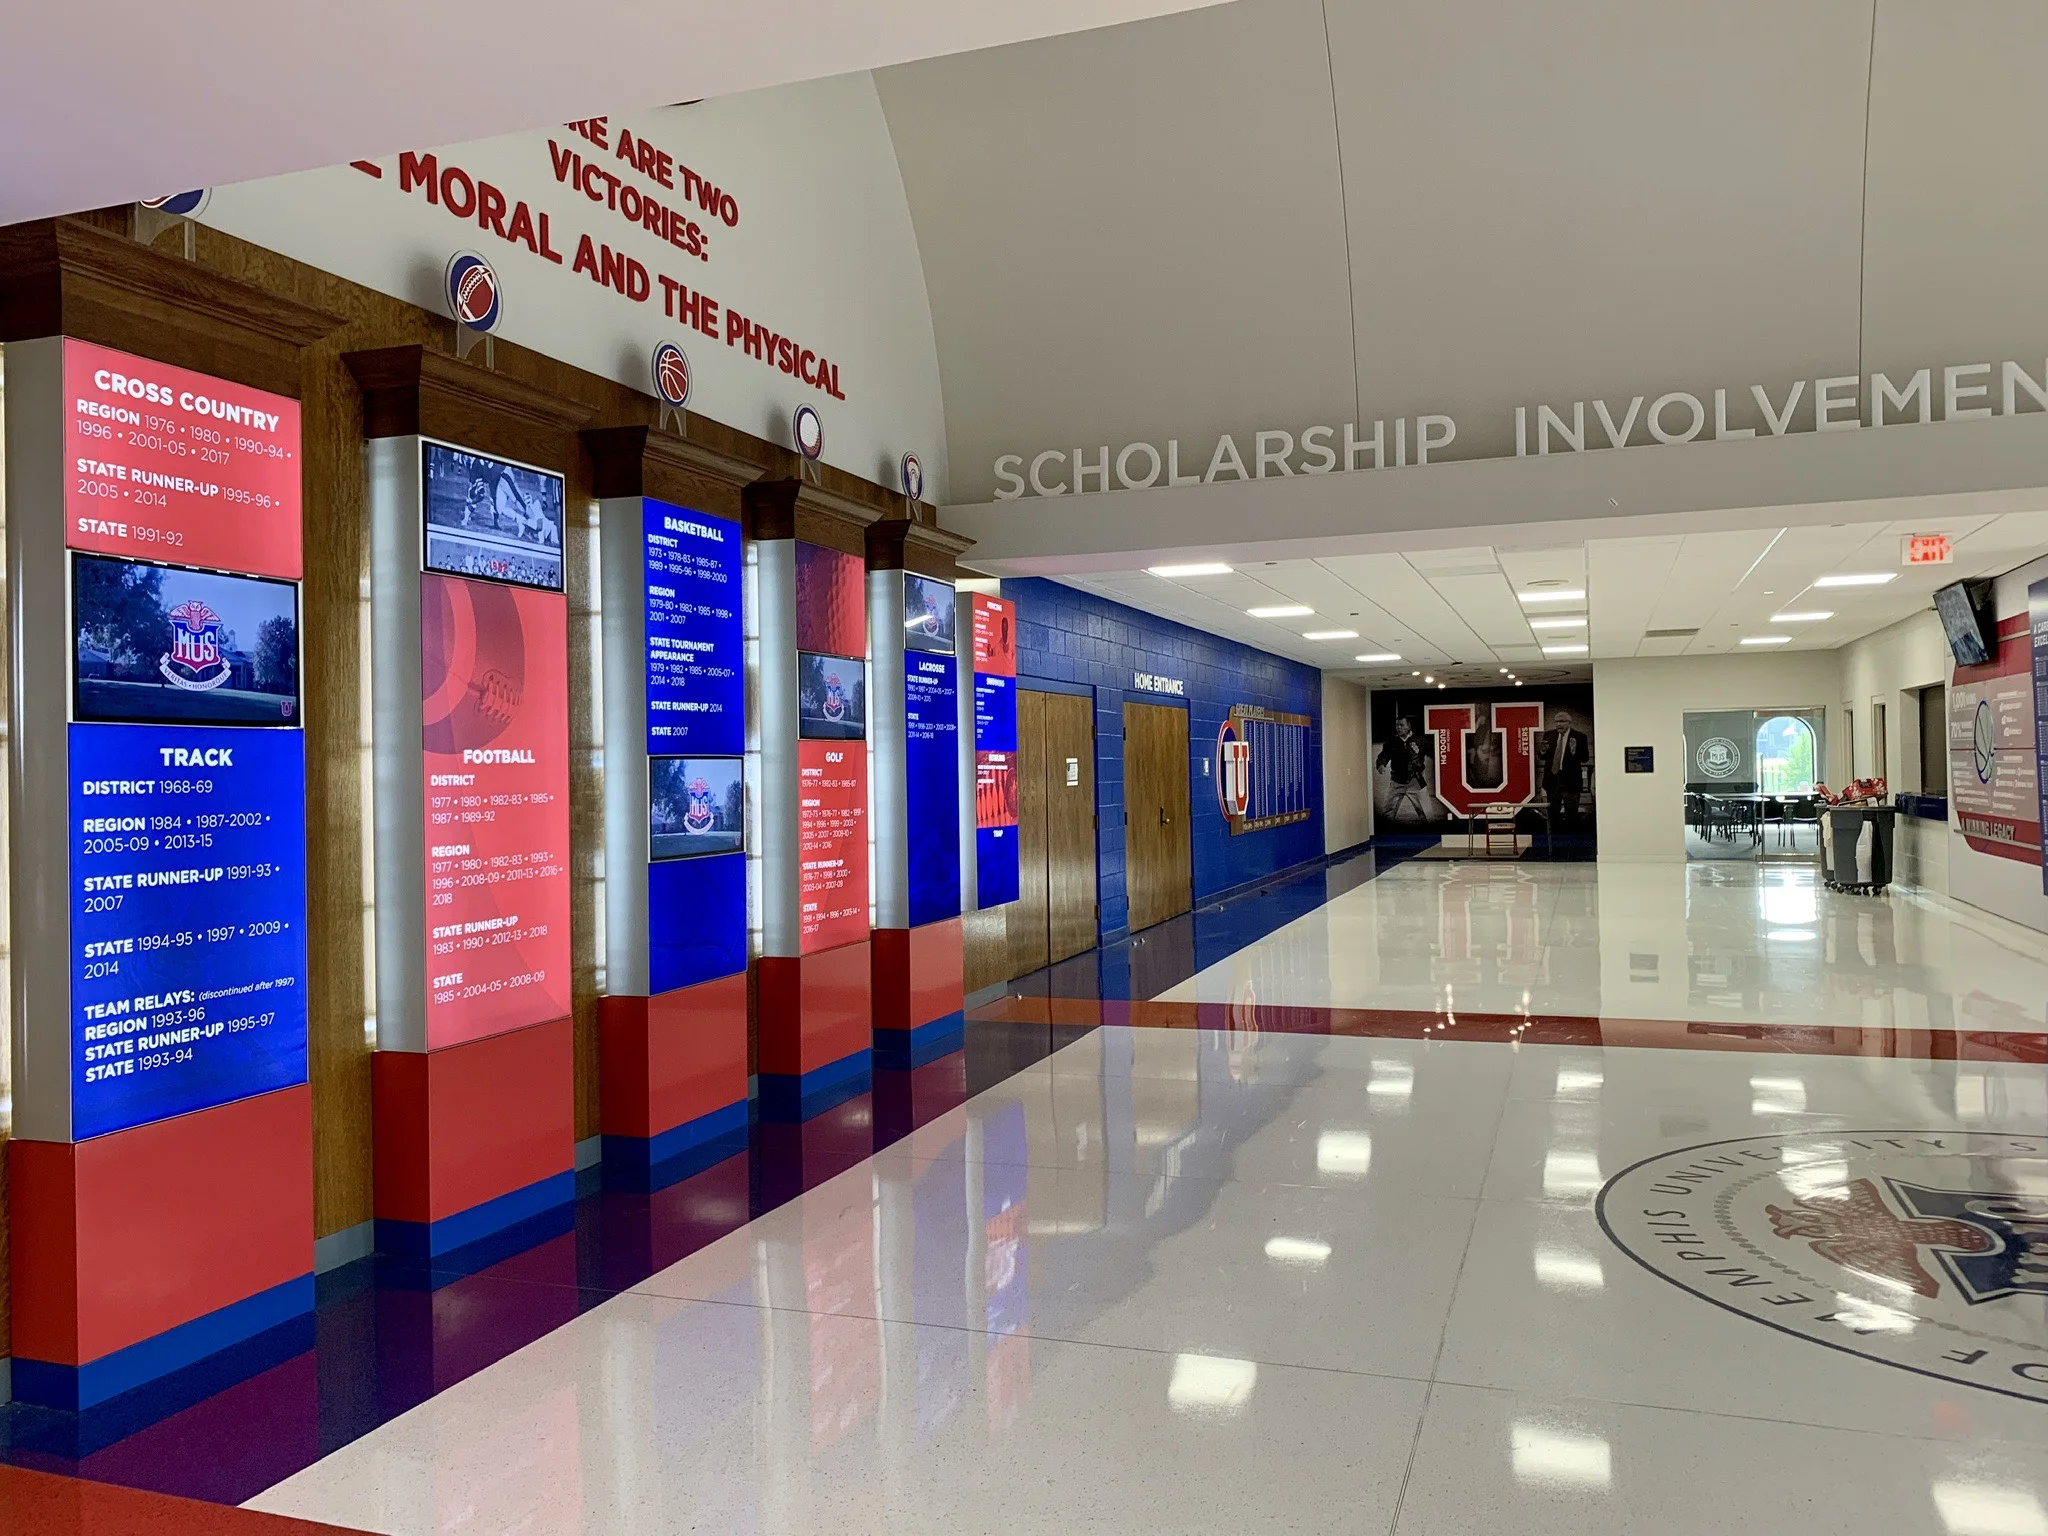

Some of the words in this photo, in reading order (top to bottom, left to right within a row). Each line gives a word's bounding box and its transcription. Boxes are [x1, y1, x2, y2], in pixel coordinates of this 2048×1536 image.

[616, 129, 673, 190] ARE
[679, 164, 739, 228] TWO
[547, 139, 709, 262] VICTORIES:
[399, 151, 563, 265] MORAL
[573, 233, 651, 302] AND
[659, 273, 719, 340] THE
[726, 308, 846, 401] PHYSICAL
[94, 370, 173, 407] CROSS
[180, 392, 279, 432] COUNTRY
[77, 399, 140, 426] REGION
[145, 415, 175, 434] 1976
[190, 426, 220, 444] 1980
[234, 436, 283, 459] 1990-94
[77, 420, 112, 440] 1996
[128, 432, 186, 456] 2001-05
[201, 447, 229, 465] 2017
[993, 414, 1457, 500] SCHOLARSHIP
[77, 459, 126, 480] STATE
[132, 469, 218, 497] RUNNER-UP
[222, 486, 270, 508] 1995-96
[77, 479, 118, 499] 2005
[134, 490, 166, 507] 2014
[78, 518, 127, 537] STATE
[132, 525, 183, 547] 1991-92
[664, 516, 723, 542] BASKETBALL
[648, 534, 678, 548] DISTRICT
[1910, 537, 1946, 562] EXIT
[648, 547, 662, 558] 1973
[649, 586, 675, 598] REGION
[650, 611, 664, 621] 2001
[670, 614, 686, 624] 2007
[177, 628, 215, 662] MUS
[650, 637, 670, 648] STATE
[671, 639, 714, 652] TOURNAMENT
[650, 650, 694, 662] APPEARANCE
[650, 663, 664, 672] 1979
[919, 661, 945, 673] LACROSSE
[164, 668, 187, 687] VERITAS
[651, 675, 665, 685] 2014
[1135, 673, 1153, 690] HOME
[1154, 676, 1183, 695] ENTRANCE
[281, 701, 292, 716] U
[651, 701, 671, 710] STATE
[672, 702, 708, 712] RUNNER-UP
[710, 704, 722, 712] 2014
[652, 727, 671, 735] STATE
[673, 727, 688, 736] 2007
[160, 748, 233, 766] TRACK
[463, 749, 535, 764] FOOTBALL
[826, 752, 843, 762] GOLF
[1424, 702, 1544, 819] U
[83, 781, 155, 795] DISTRICT
[159, 780, 212, 794] 1968-69
[431, 775, 475, 786] DISTRICT
[1224, 741, 1249, 815] U
[431, 797, 451, 808] 1977
[461, 796, 481, 807] 1980
[490, 794, 522, 805] 1982-83
[531, 793, 548, 803] 1985
[802, 799, 820, 807] REGION
[84, 818, 145, 833] REGION
[150, 816, 181, 830] 1984
[196, 813, 262, 828] 1987-2002
[431, 813, 452, 824] 1987
[461, 811, 495, 823] 1989-92
[1990, 822, 2015, 840] LEGACY
[84, 837, 149, 854] 2005-09
[164, 834, 212, 849] 2013-15
[432, 845, 470, 857] REGION
[432, 862, 452, 873] 1977
[461, 859, 481, 871] 1980
[491, 855, 522, 867] 1982-83
[531, 852, 548, 863] 1993
[802, 861, 817, 870] STATE
[84, 875, 132, 891] STATE
[138, 868, 223, 887] RUNNER-UP
[227, 863, 271, 880] 1991-93
[433, 878, 453, 889] 1996
[461, 873, 499, 886] 2008-09
[507, 868, 533, 881] 2011-13
[540, 865, 557, 877] 2016
[84, 896, 123, 913] 2007
[433, 893, 452, 905] 2018
[803, 903, 817, 912] STATE
[433, 924, 462, 939] STATE
[465, 916, 518, 933] RUNNER-UP
[84, 939, 133, 958] STATE
[138, 932, 193, 951] 1994-95
[207, 926, 235, 943] 1997
[249, 921, 280, 937] 2009
[433, 941, 453, 955] 1983
[463, 938, 483, 950] 1990
[492, 929, 521, 945] 2012-13
[529, 925, 547, 938] 2018
[84, 961, 119, 980] 2014
[433, 973, 463, 988] STATE
[434, 991, 454, 1004] 1985
[463, 980, 501, 998] 2004-05
[510, 970, 545, 988] 2008-09
[84, 1000, 129, 1020] TEAM
[134, 991, 194, 1012] RELAYS:
[199, 984, 253, 1002] (discontinued
[255, 981, 273, 991] after
[275, 977, 294, 987] 1997)
[85, 1017, 147, 1041] REGION
[151, 1007, 205, 1028] 1993-96
[85, 1040, 133, 1061] STATE
[138, 1022, 224, 1051] RUNNER-UP
[227, 1012, 275, 1033] 1995-97
[86, 1059, 134, 1082] STATE
[138, 1048, 193, 1071] 1993-94
